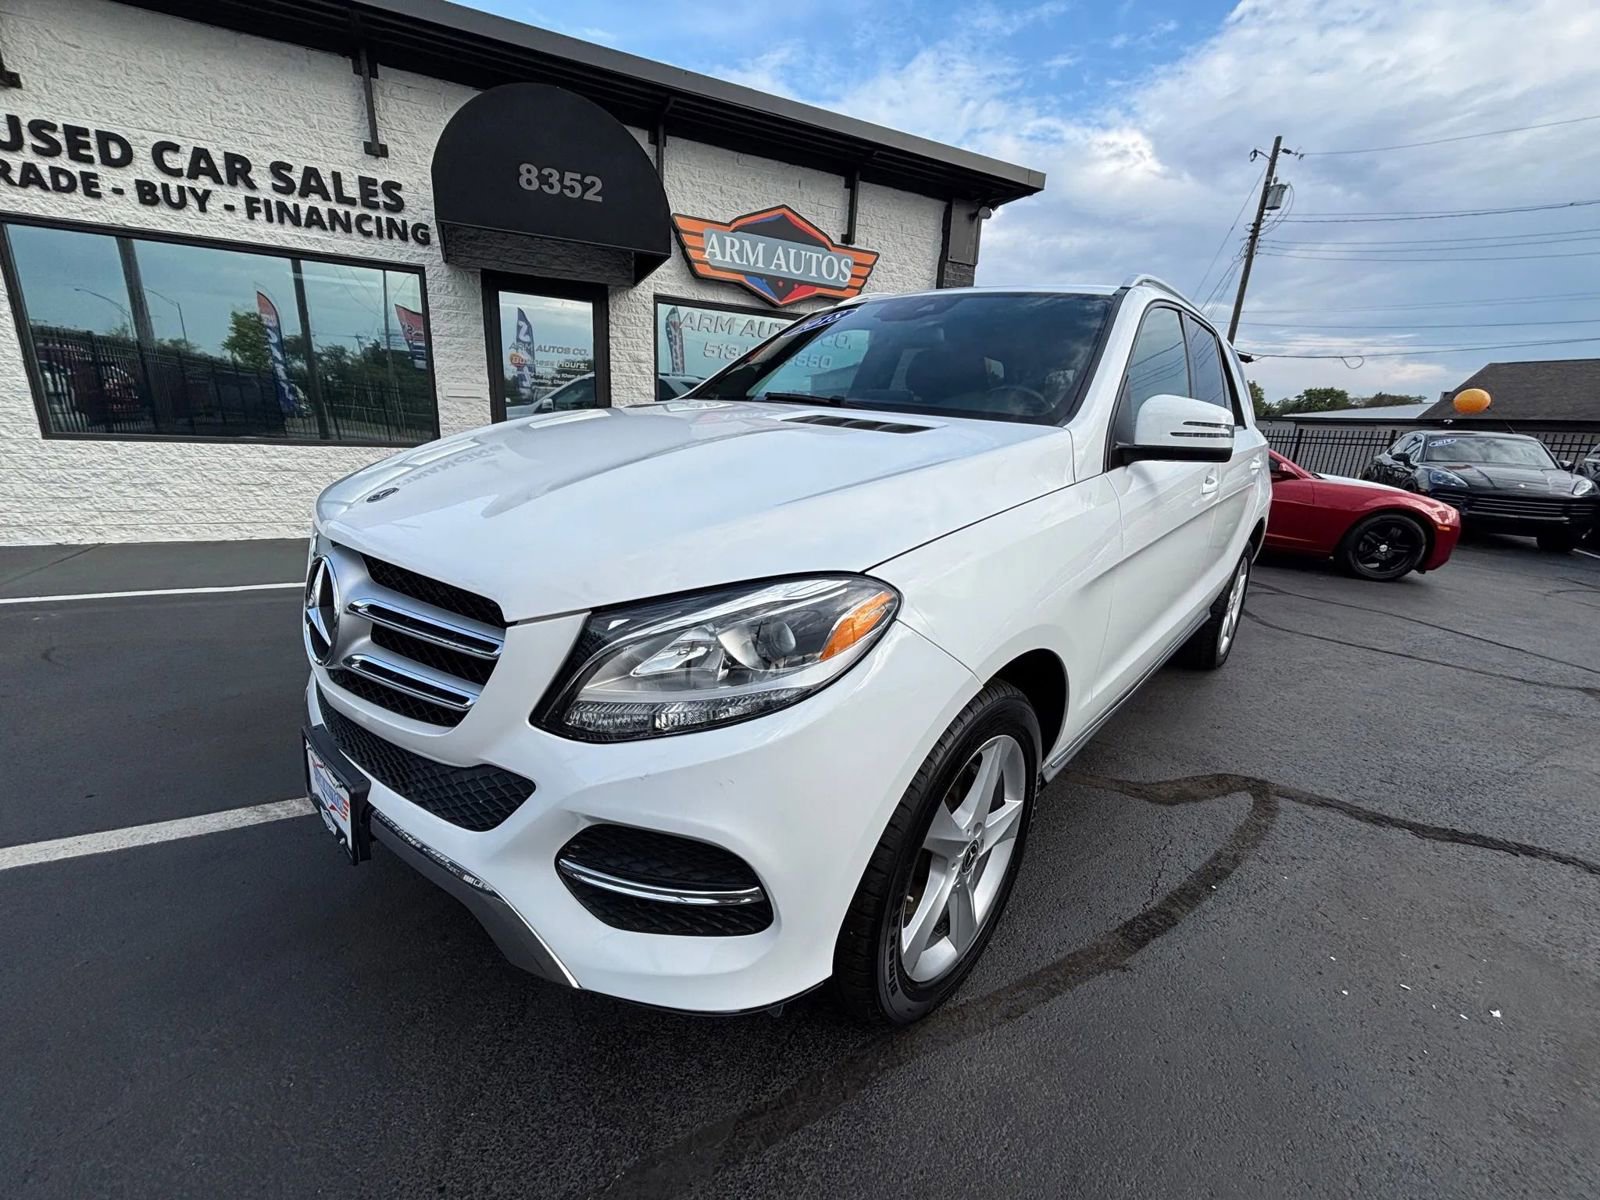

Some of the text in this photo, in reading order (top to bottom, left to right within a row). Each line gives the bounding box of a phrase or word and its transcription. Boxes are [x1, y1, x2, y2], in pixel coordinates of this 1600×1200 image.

[0, 113, 405, 213] USED CAR SALES
[519, 163, 602, 202] 8352
[135, 179, 212, 213] BUY
[245, 196, 431, 246] FINANCING
[703, 233, 853, 283] ARM AUTOS
[680, 311, 737, 336] ARM
[739, 318, 789, 340] AUT
[536, 344, 571, 355] AUTOS
